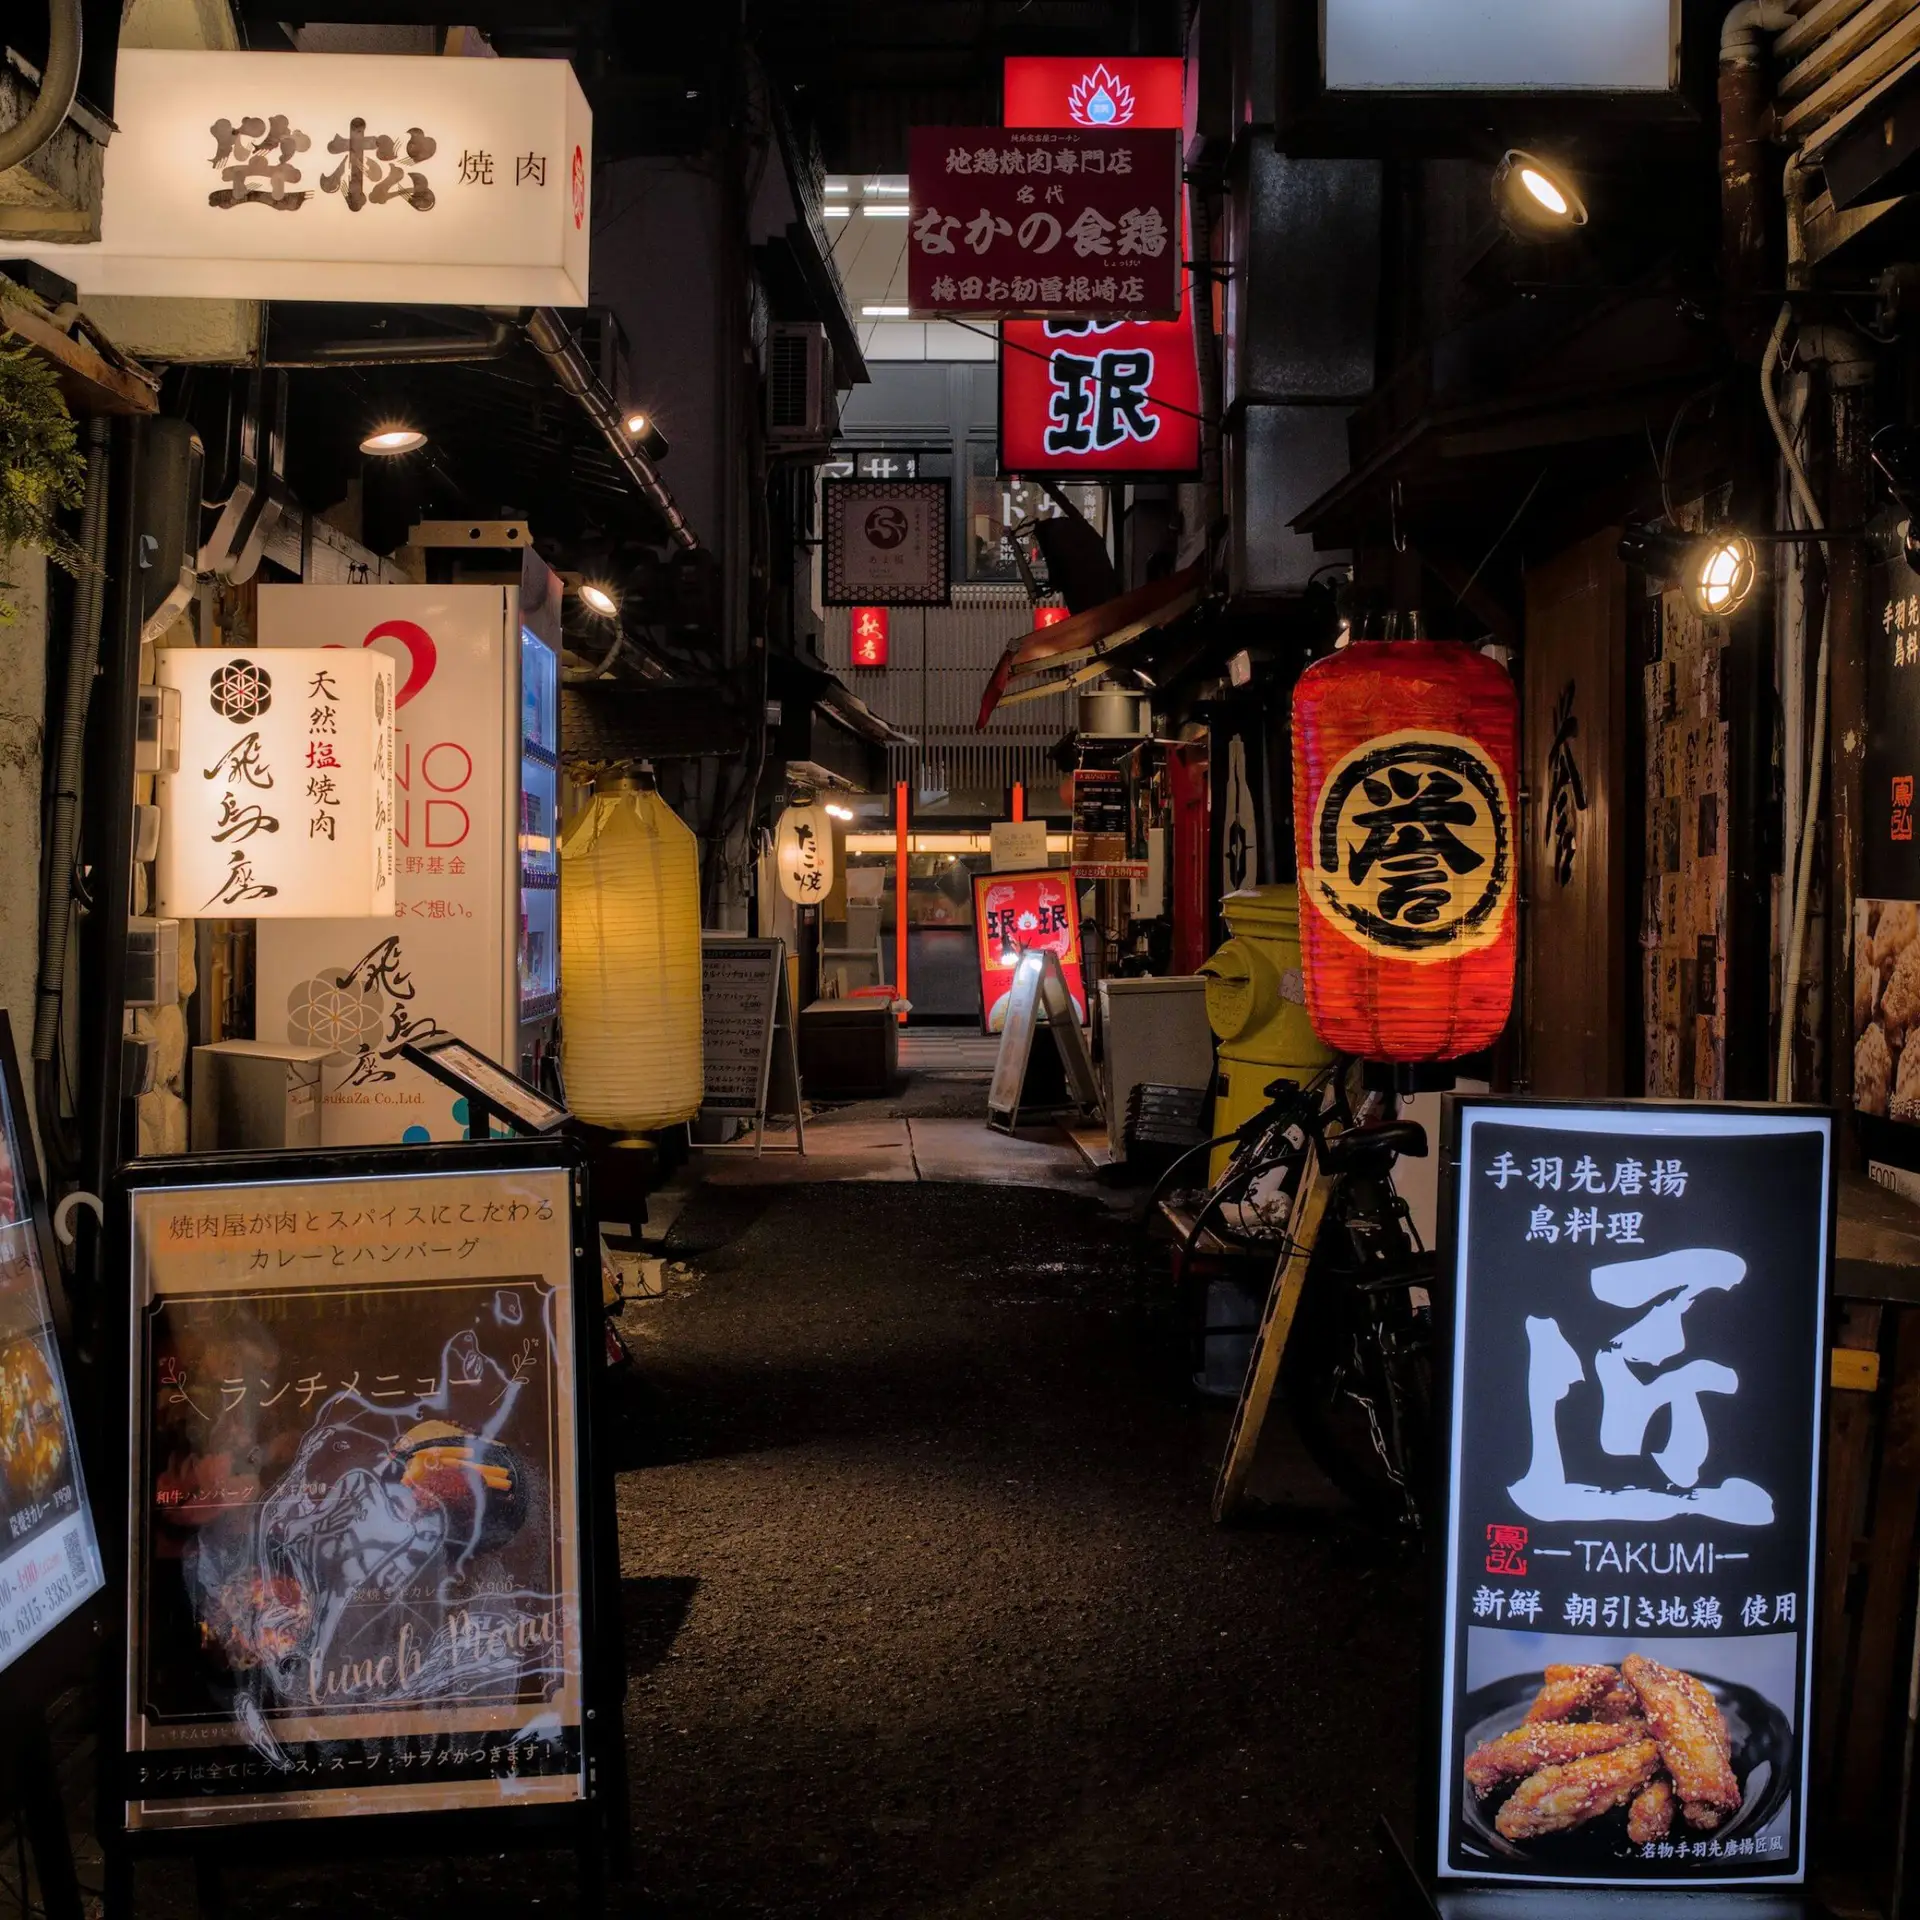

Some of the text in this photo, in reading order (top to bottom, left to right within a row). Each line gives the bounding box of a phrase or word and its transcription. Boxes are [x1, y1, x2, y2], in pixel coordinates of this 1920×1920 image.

[458, 150, 547, 187] 焼肉
[945, 147, 1134, 176] 地鶏焼肉専門店
[1016, 184, 1065, 205] 名代
[912, 206, 1168, 258] なかの食鶏
[931, 275, 1145, 303] 梅田お初曽根崎店
[1042, 320, 1162, 456] 珉
[305, 670, 342, 841] 天然塩焼肉
[794, 824, 822, 892] たこ焼
[1347, 764, 1487, 929] 誉
[1485, 1151, 1690, 1198] 手羽先唐揚
[168, 1198, 556, 1241] 焼肉屋が肉とスパイスにこだわる
[1525, 1204, 1645, 1246] 鳥料理
[249, 1237, 481, 1271] カレーとハンバーグ
[220, 1371, 482, 1412] ランチメニュー
[1506, 1247, 1776, 1526] 匠
[1472, 1585, 1797, 1630] 新鮮 朝引き地鶏 使用
[306, 1623, 424, 1706] Lunch
[1639, 1836, 1784, 1859] 名物手羽先唐揚匠風
